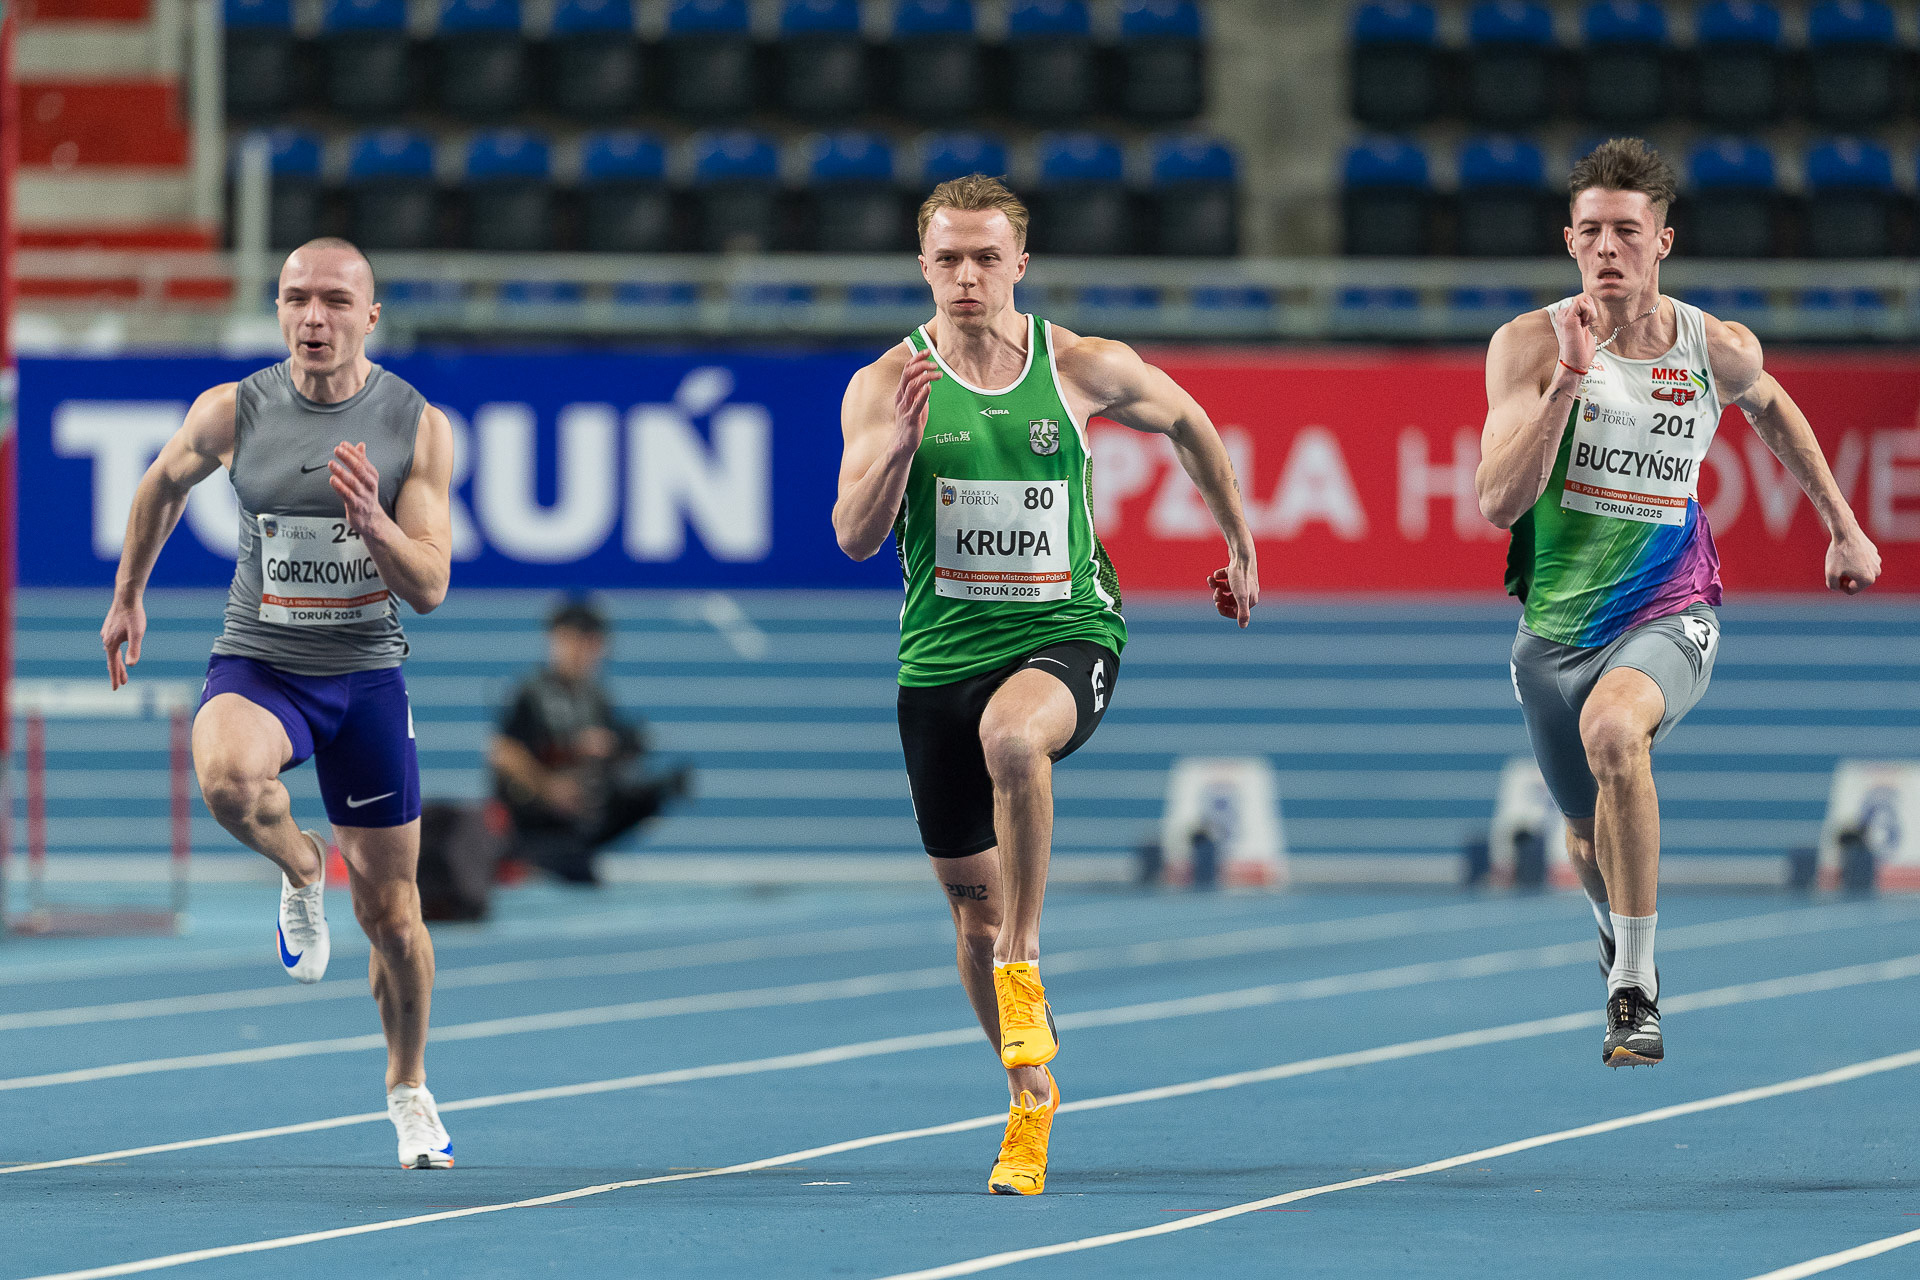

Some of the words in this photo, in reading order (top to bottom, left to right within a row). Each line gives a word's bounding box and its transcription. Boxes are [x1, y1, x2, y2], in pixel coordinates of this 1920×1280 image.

[1651, 367, 1689, 382] MKS
[1601, 414, 1637, 427] TORUŃ
[1603, 408, 1630, 417] MIASTO
[1650, 412, 1695, 439] 201
[52, 365, 775, 564] TUŃ
[1575, 441, 1693, 483] BUCZYŃSKI
[960, 493, 1000, 506] TORUŃ
[1023, 487, 1054, 510] 80
[1582, 486, 1600, 496] PZLA
[1600, 489, 1628, 500] Halowe
[1628, 493, 1669, 505] Mistrzostwa
[1669, 498, 1686, 506] Polski
[1594, 501, 1634, 515] TORUŃ
[1636, 508, 1663, 519] 2025
[281, 529, 317, 540] TORUŃ
[956, 528, 1052, 557] KRUPA
[267, 556, 379, 585] GORZKOWIC
[952, 571, 970, 580] PZLA
[971, 572, 1000, 581] Halowe
[1001, 573, 1045, 582] Mistrzostwa
[1045, 572, 1067, 581] Polski
[966, 584, 1009, 597] TORUŃ
[1011, 587, 1041, 597] 2025
[291, 609, 332, 620] TORUŃ
[334, 610, 362, 620] 2025
[1692, 619, 1711, 652] 3
